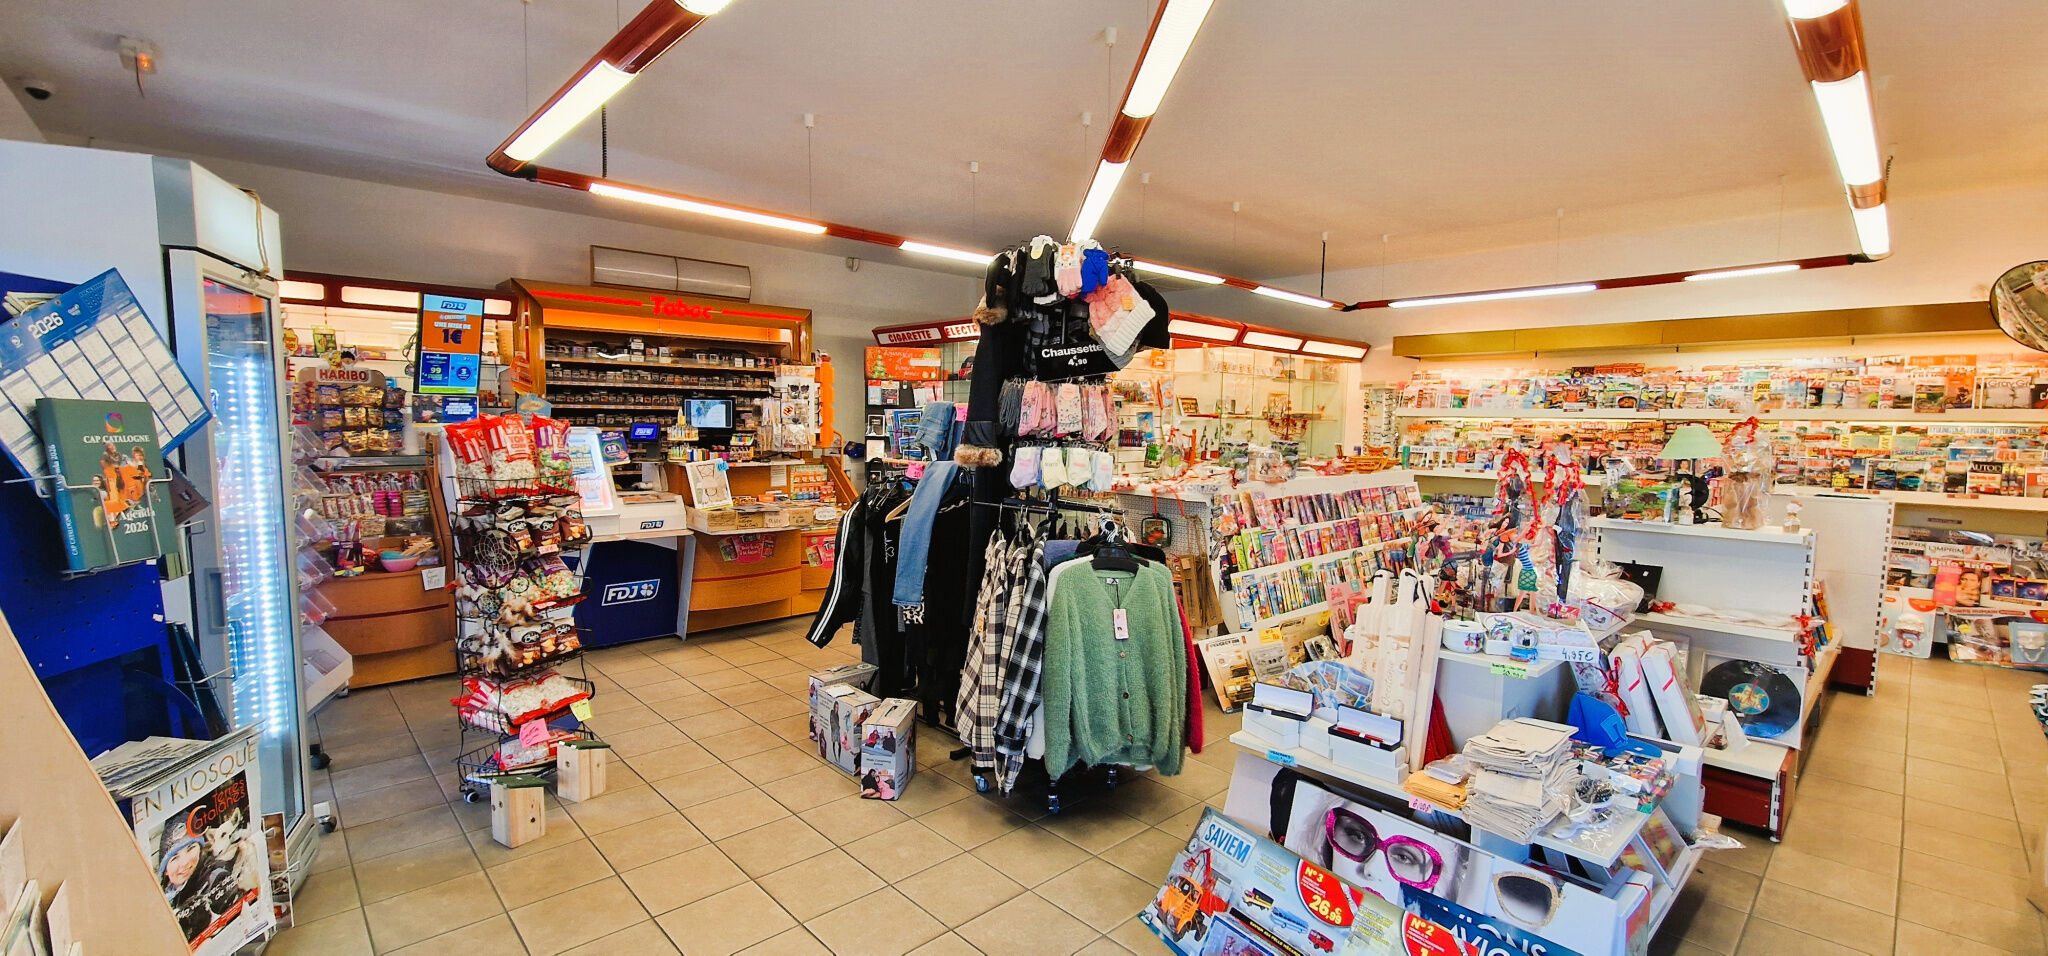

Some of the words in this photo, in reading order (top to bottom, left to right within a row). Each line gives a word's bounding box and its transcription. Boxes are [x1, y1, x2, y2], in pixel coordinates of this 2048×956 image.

[650, 296, 713, 320] Tabac
[28, 312, 64, 339] 2026
[888, 331, 932, 343] CIGARETTE
[945, 324, 979, 336] ELECTR
[442, 329, 463, 345] 1€
[319, 369, 367, 380] HARIBO
[83, 436, 101, 444] CAP
[102, 435, 151, 443] CATALOGNE
[63, 513, 77, 544] CATALOGNE
[124, 521, 148, 534] 2026
[641, 521, 656, 529] FDJ
[68, 545, 79, 555] CAP
[607, 585, 638, 601] FDJ
[133, 791, 163, 824] EN
[170, 741, 258, 804] KIOSQUE
[212, 779, 245, 804] Terres
[186, 788, 246, 838] Catalanes
[1204, 823, 1251, 865] SAVIEM
